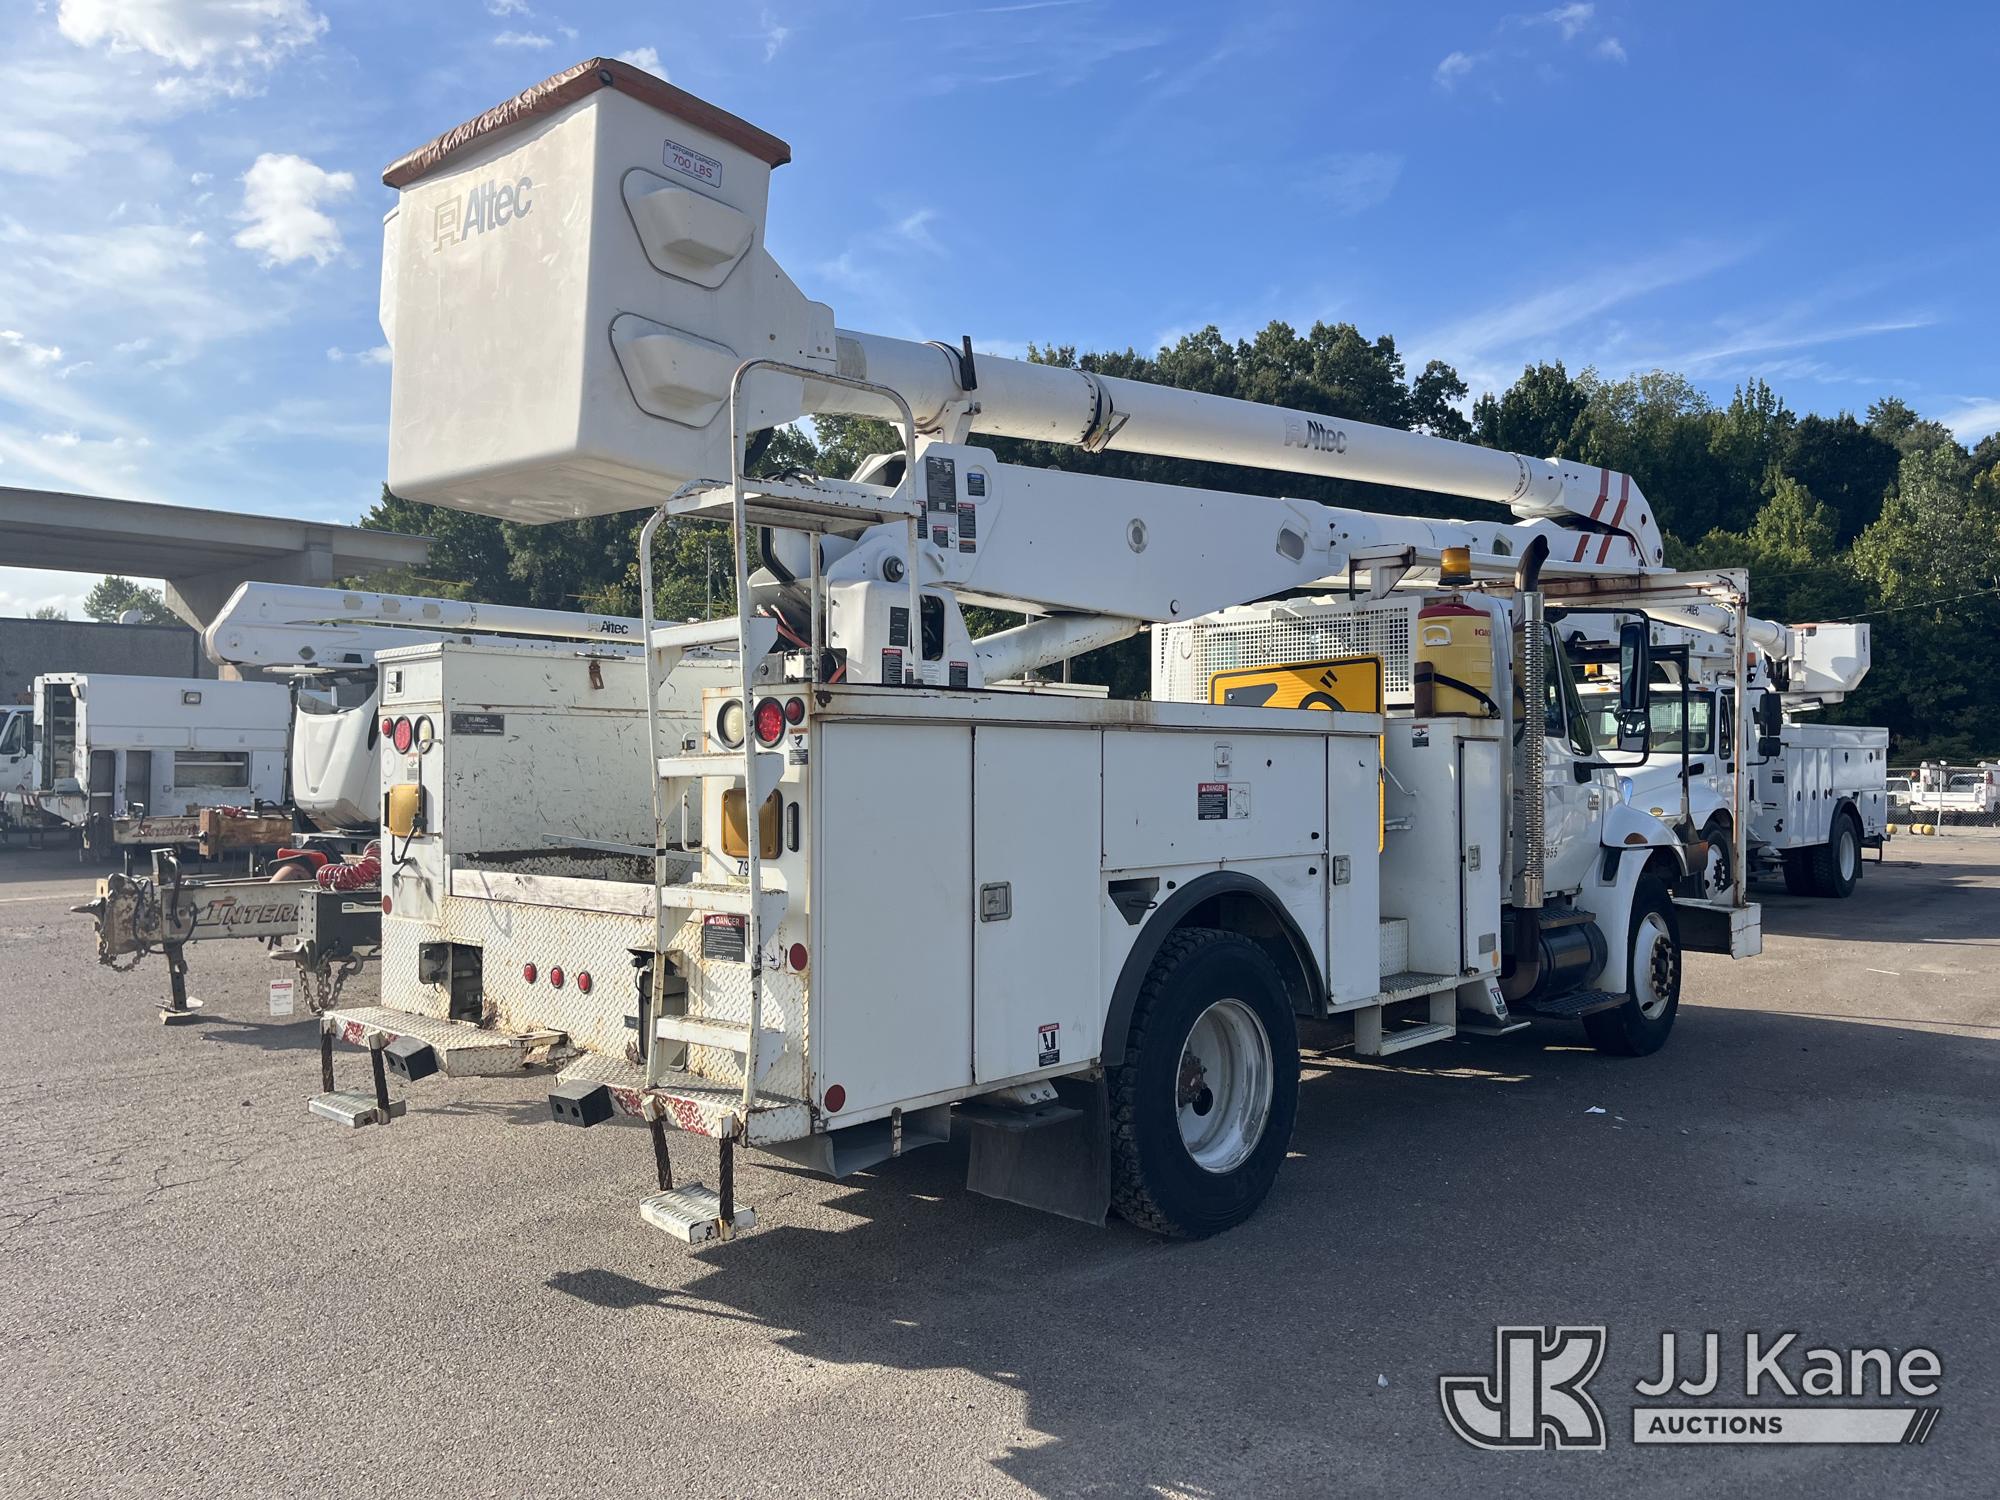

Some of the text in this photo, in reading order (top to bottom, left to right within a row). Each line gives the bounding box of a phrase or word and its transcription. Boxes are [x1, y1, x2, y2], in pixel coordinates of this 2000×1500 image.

[673, 153, 691, 169] 700
[694, 162, 713, 178] LBS
[461, 177, 532, 241] Altec
[1304, 420, 1347, 455] Altec
[601, 621, 629, 635] Altec
[715, 916, 740, 926] DANGER
